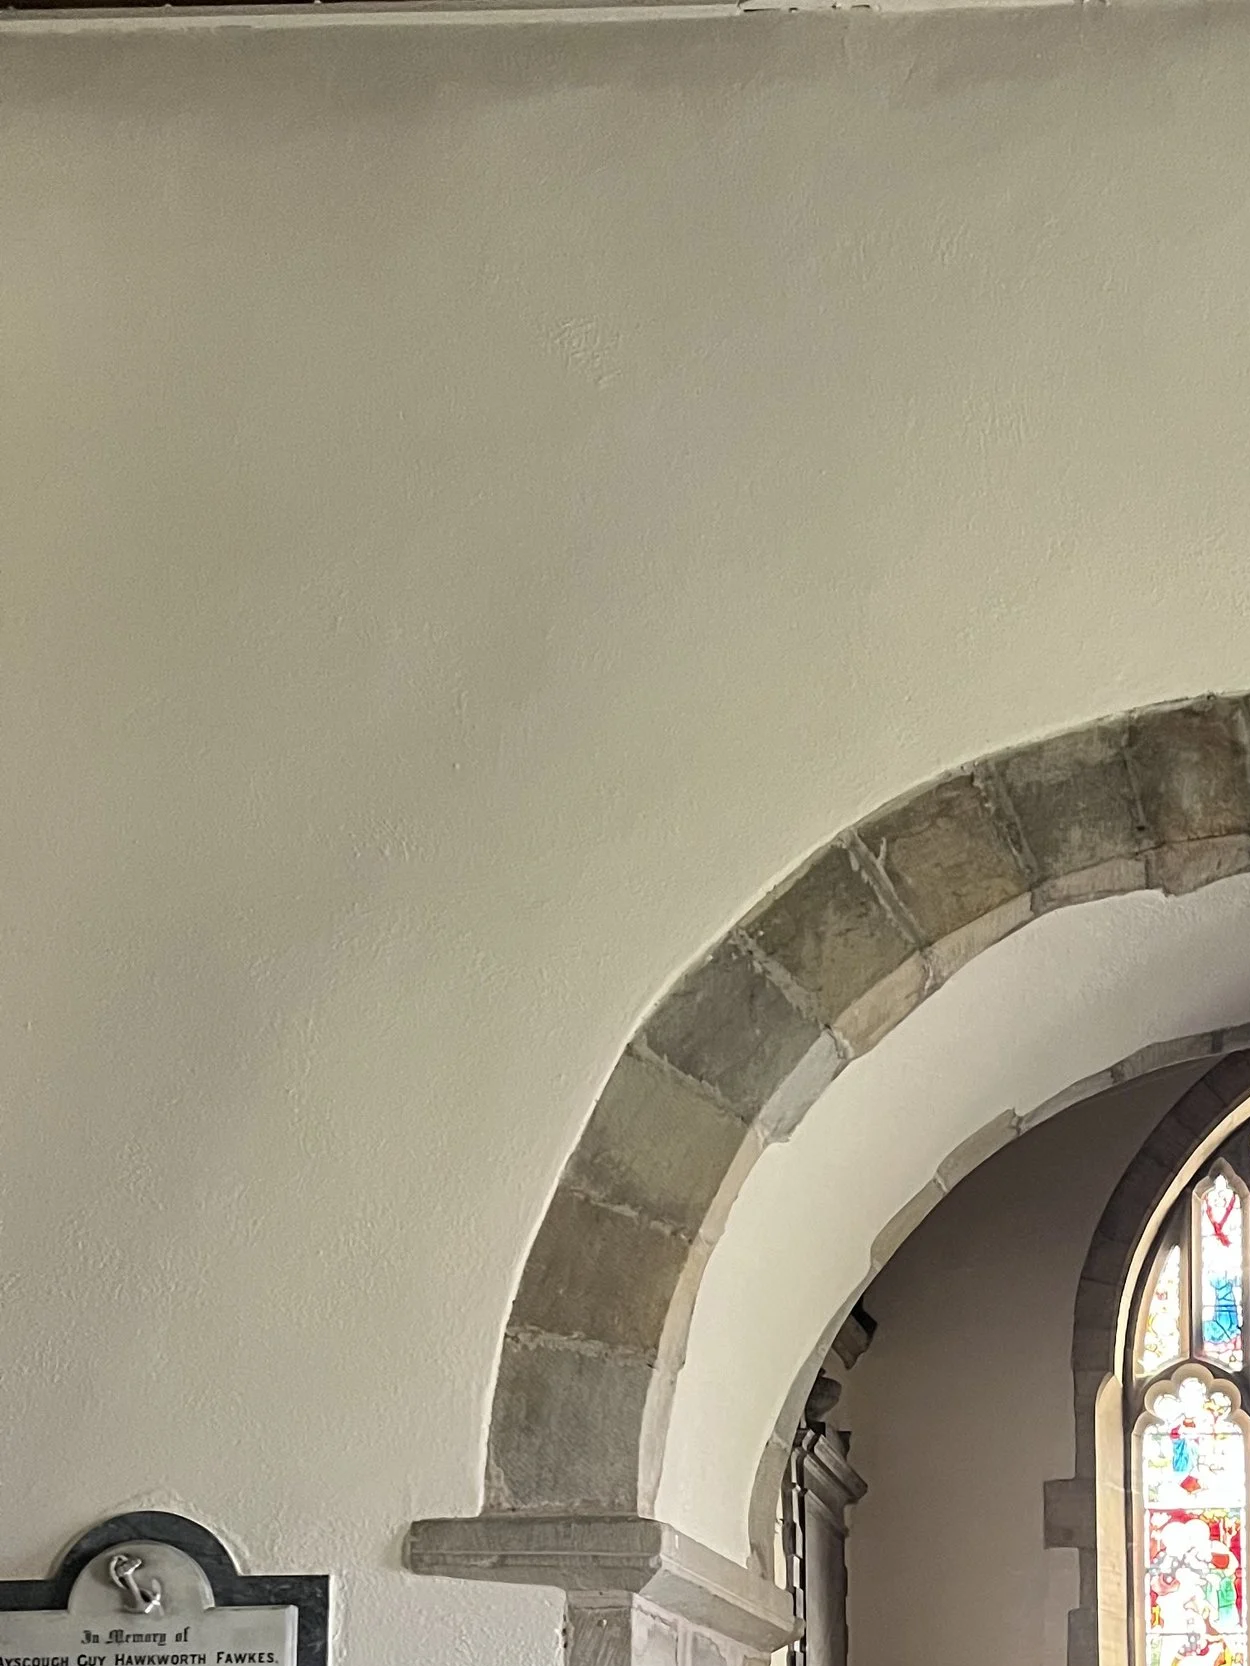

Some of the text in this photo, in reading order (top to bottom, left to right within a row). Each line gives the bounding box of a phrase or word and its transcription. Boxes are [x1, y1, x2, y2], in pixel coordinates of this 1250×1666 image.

[81, 1626, 190, 1646] In Memory of
[77, 1654, 106, 1666] GUY
[115, 1653, 206, 1666] HAWKWORTH
[216, 1651, 279, 1664] FAWKES.
